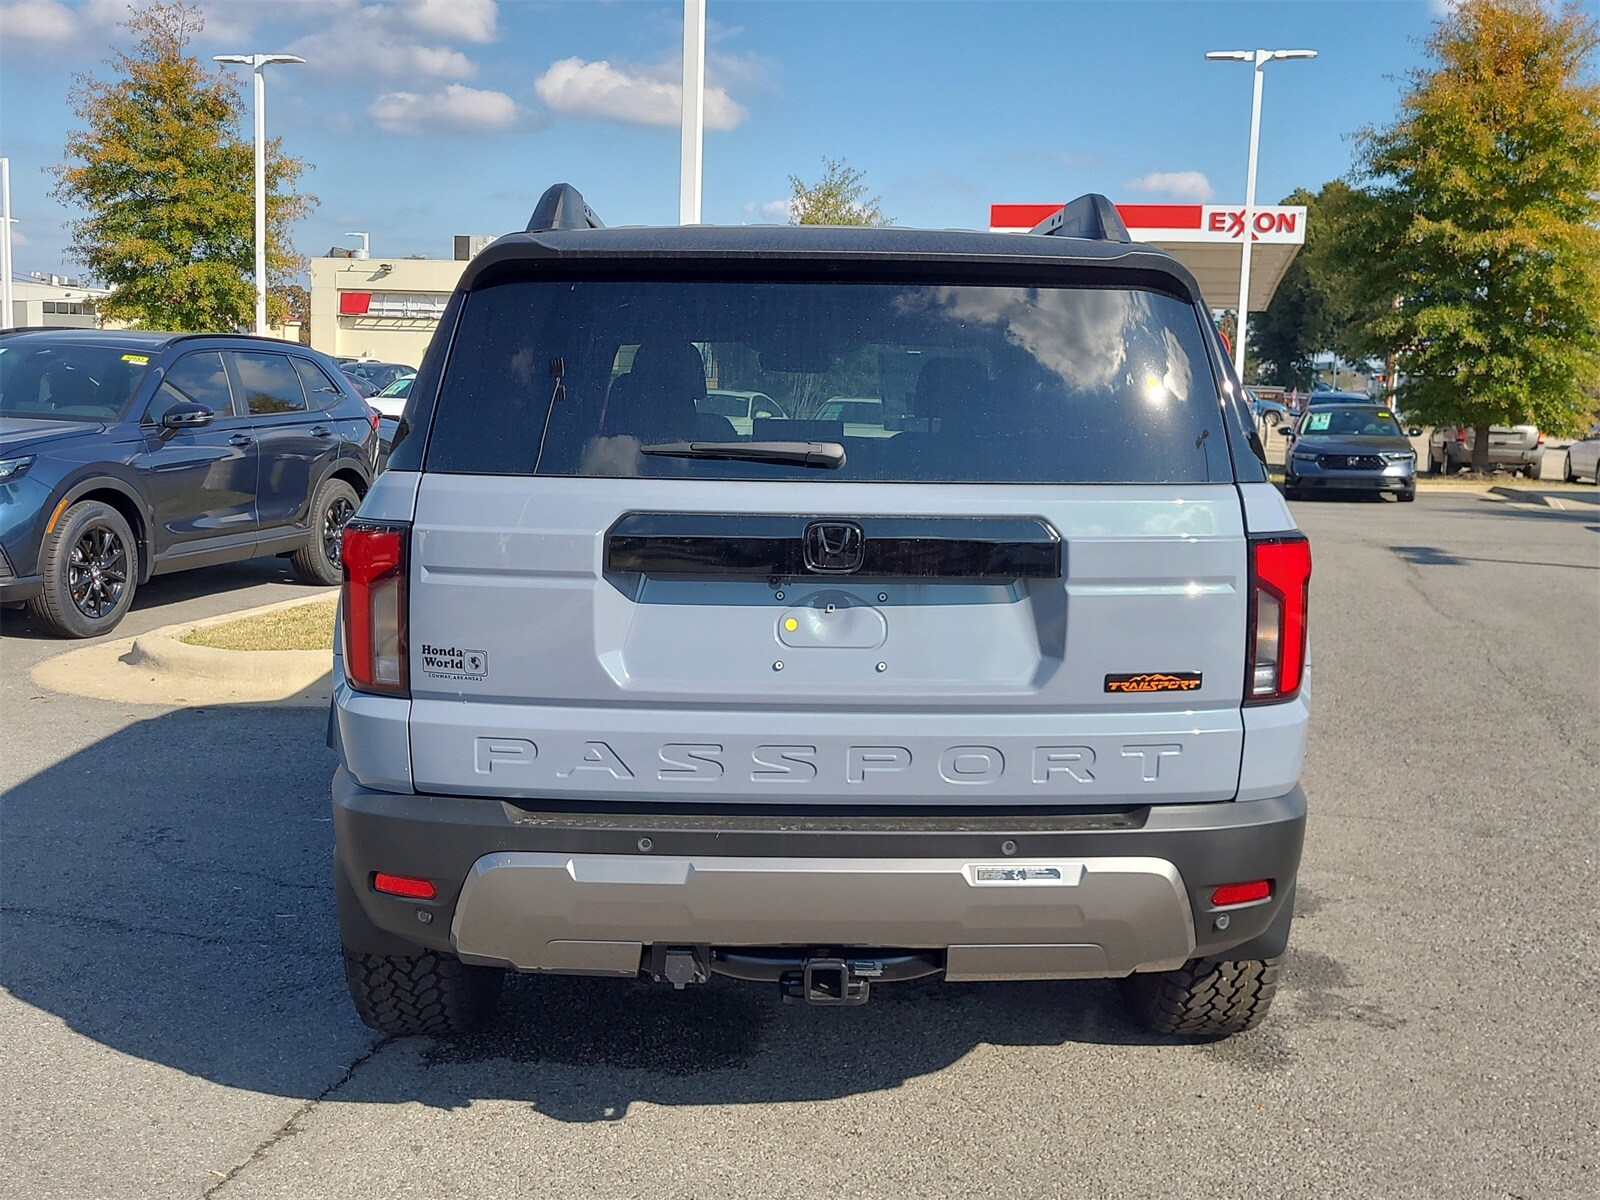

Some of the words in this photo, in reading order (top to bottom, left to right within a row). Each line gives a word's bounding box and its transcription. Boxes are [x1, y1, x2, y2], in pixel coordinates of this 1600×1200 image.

[1208, 209, 1296, 240] EXXON
[421, 644, 463, 657] Honda
[424, 656, 463, 669] World
[1109, 680, 1199, 691] TRAILSPORT
[473, 736, 1183, 785] PASSPORT
